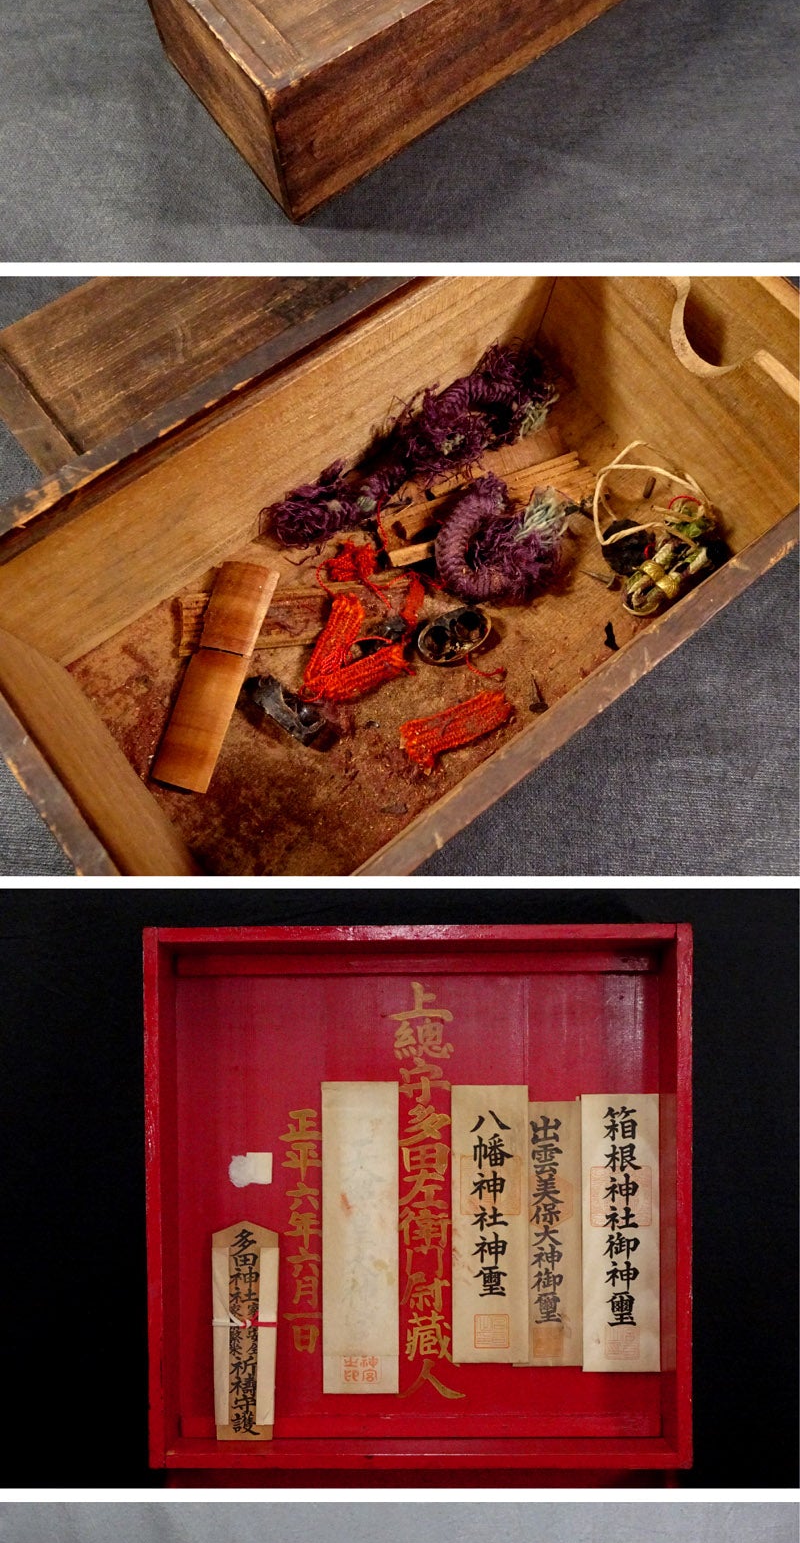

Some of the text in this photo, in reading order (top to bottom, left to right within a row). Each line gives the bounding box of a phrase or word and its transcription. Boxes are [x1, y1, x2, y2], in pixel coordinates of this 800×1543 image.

[470, 1110, 514, 1297] 八幡神社神璽
